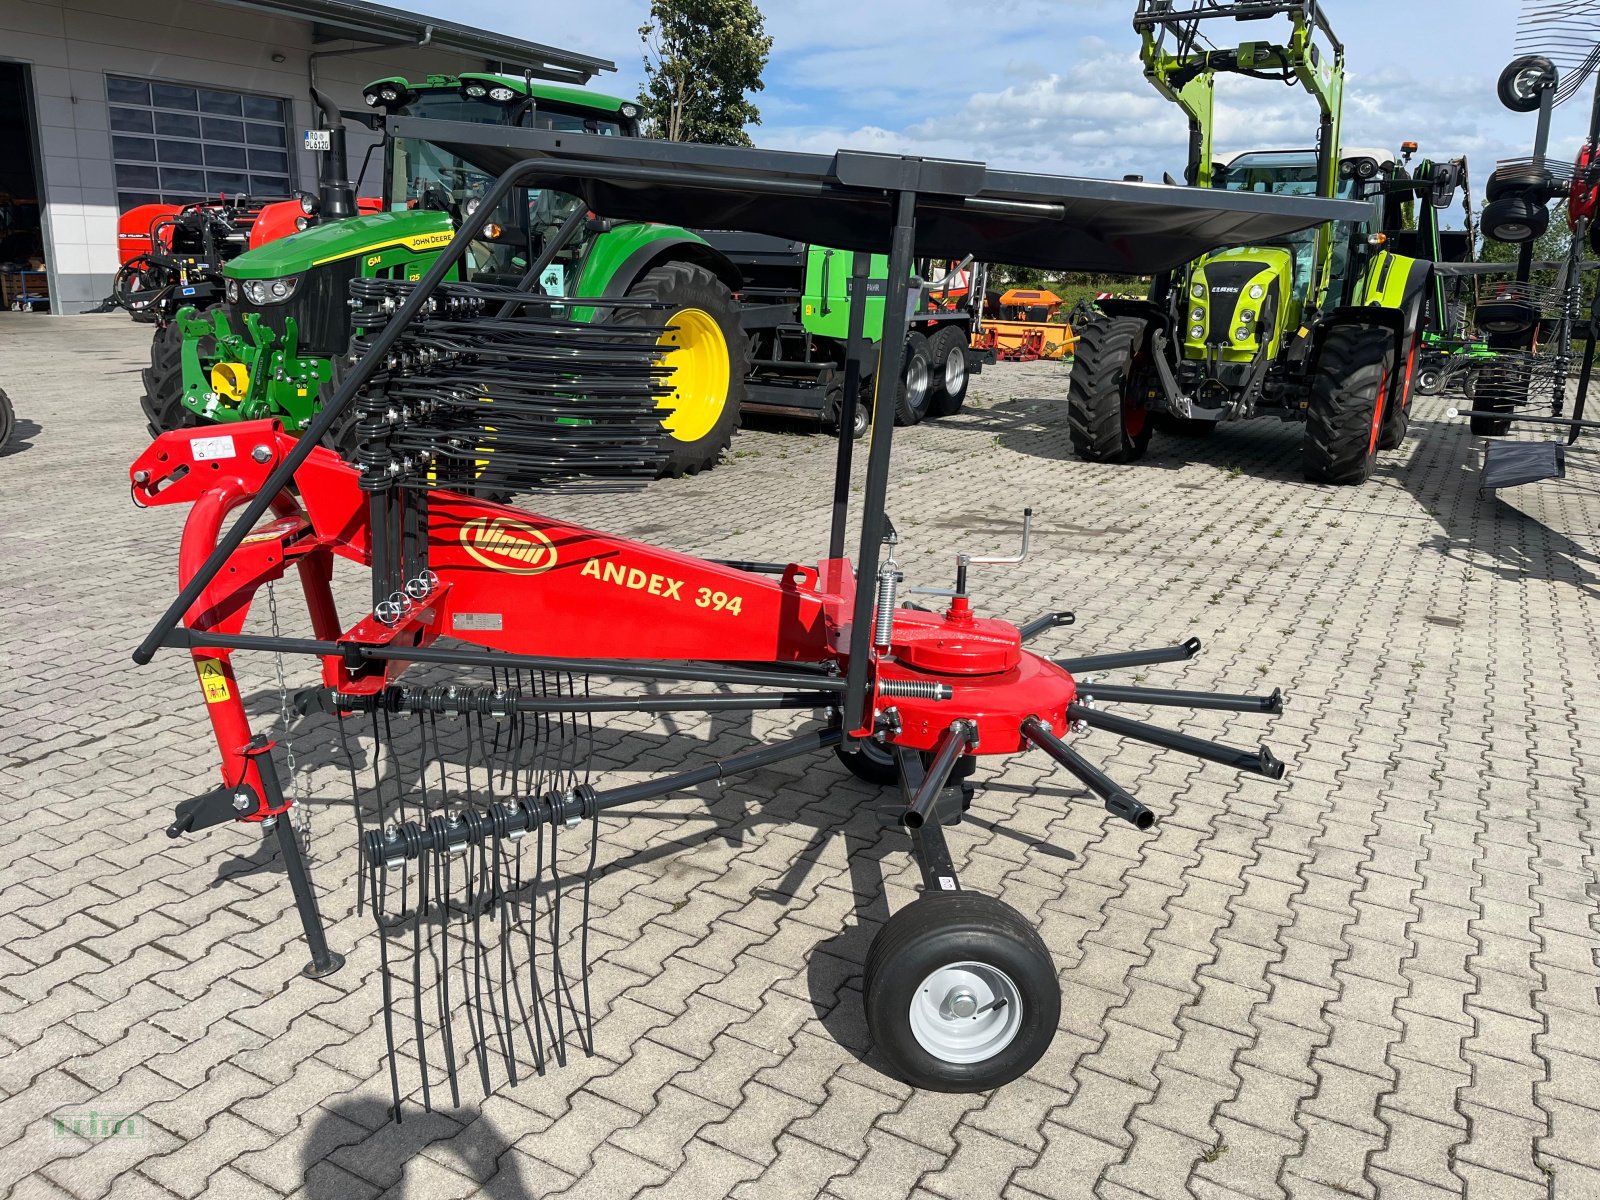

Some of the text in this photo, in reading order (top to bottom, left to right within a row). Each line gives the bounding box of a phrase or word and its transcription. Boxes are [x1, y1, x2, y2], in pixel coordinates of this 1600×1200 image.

[413, 234, 452, 247] JOHN DEERE
[367, 256, 381, 267] 6M
[473, 517, 546, 565] Vicon
[580, 557, 743, 617] ANDEX 394
